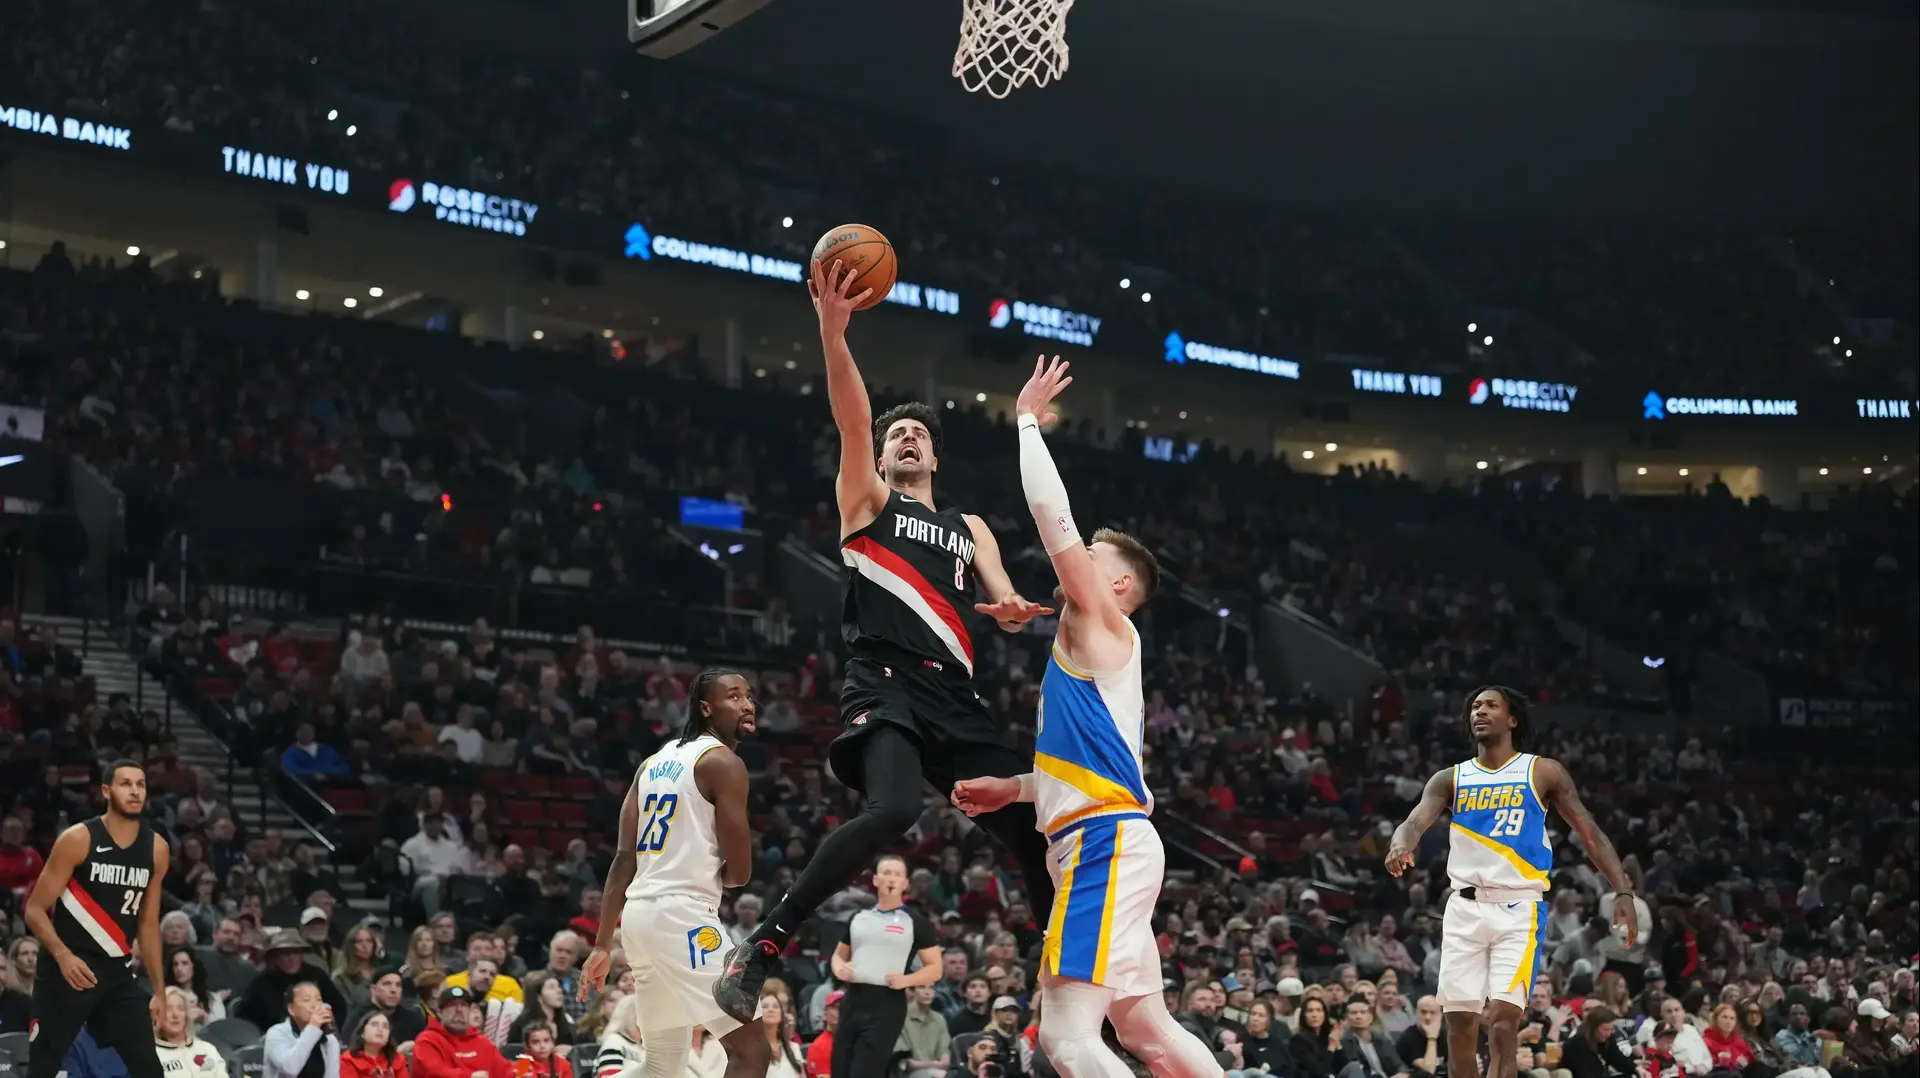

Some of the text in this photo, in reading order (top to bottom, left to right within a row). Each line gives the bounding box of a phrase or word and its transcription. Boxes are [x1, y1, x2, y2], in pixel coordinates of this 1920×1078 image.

[63, 117, 131, 150] BANK
[222, 146, 349, 195] THANK YOU
[435, 205, 526, 236] PARTNERS
[652, 234, 803, 283] COLUMBIA BANK
[925, 287, 959, 315] YOU
[1185, 341, 1300, 380] COLUMBIA BANK
[1352, 369, 1442, 397] THANK YOU
[1503, 397, 1570, 413] PARTNERS
[1666, 398, 1798, 416] COLUMBIA BANK
[1856, 398, 1911, 418] THANK
[894, 513, 976, 566] PORTLAND
[954, 556, 965, 591] 8
[649, 759, 684, 784] NESMITH
[1456, 784, 1527, 813] PACERS
[636, 793, 680, 855] 23
[1489, 808, 1526, 838] 29
[90, 861, 150, 888] PORTLAND
